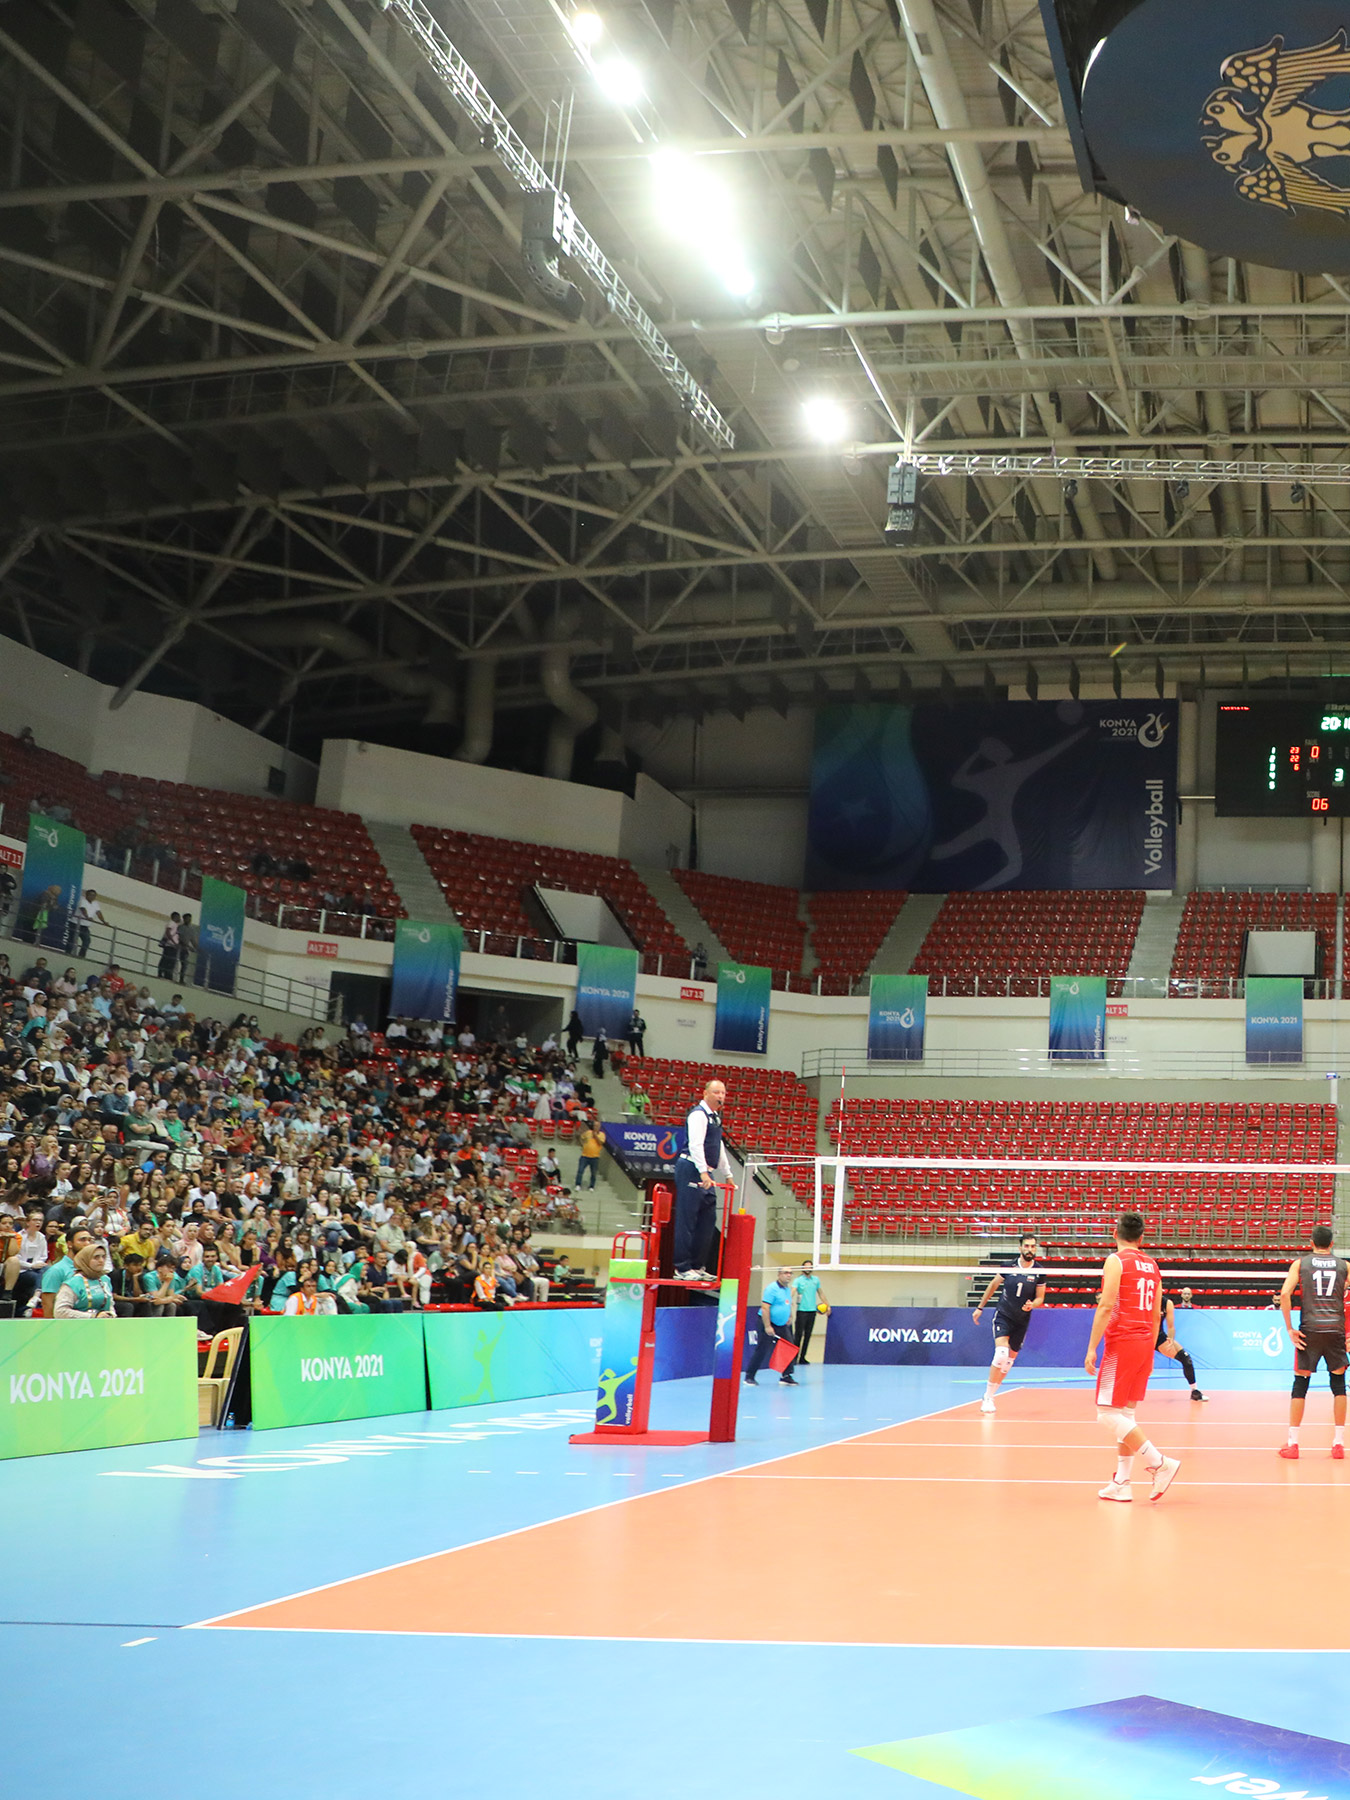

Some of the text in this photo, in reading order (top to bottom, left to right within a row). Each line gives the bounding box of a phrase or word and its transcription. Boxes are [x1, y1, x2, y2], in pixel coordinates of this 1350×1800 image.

[1099, 719, 1137, 728] KONYA
[1112, 728, 1137, 736] 2021
[1289, 746, 1301, 754] 23
[1289, 754, 1301, 763] 22
[1334, 768, 1344, 782] 3
[1311, 798, 1329, 811] 06
[1144, 780, 1168, 875] Volleyball
[308, 943, 323, 953] ALT
[580, 986, 630, 999] KONYA 2021
[681, 989, 693, 998] ALT
[1105, 1006, 1117, 1015] ALT
[1251, 1016, 1298, 1024] KONYA 2021
[624, 1131, 657, 1142] KONYA
[634, 1141, 657, 1151] 2021
[1312, 1269, 1337, 1296] 17
[1015, 1282, 1023, 1297] 1
[1136, 1277, 1155, 1311] 16
[868, 1328, 953, 1343] KONYA 2021
[1232, 1331, 1262, 1339] KONYA
[300, 1354, 384, 1382] KONYA 2021
[10, 1368, 145, 1404] KONYA 2021
[97, 1431, 522, 1479] KONYA
